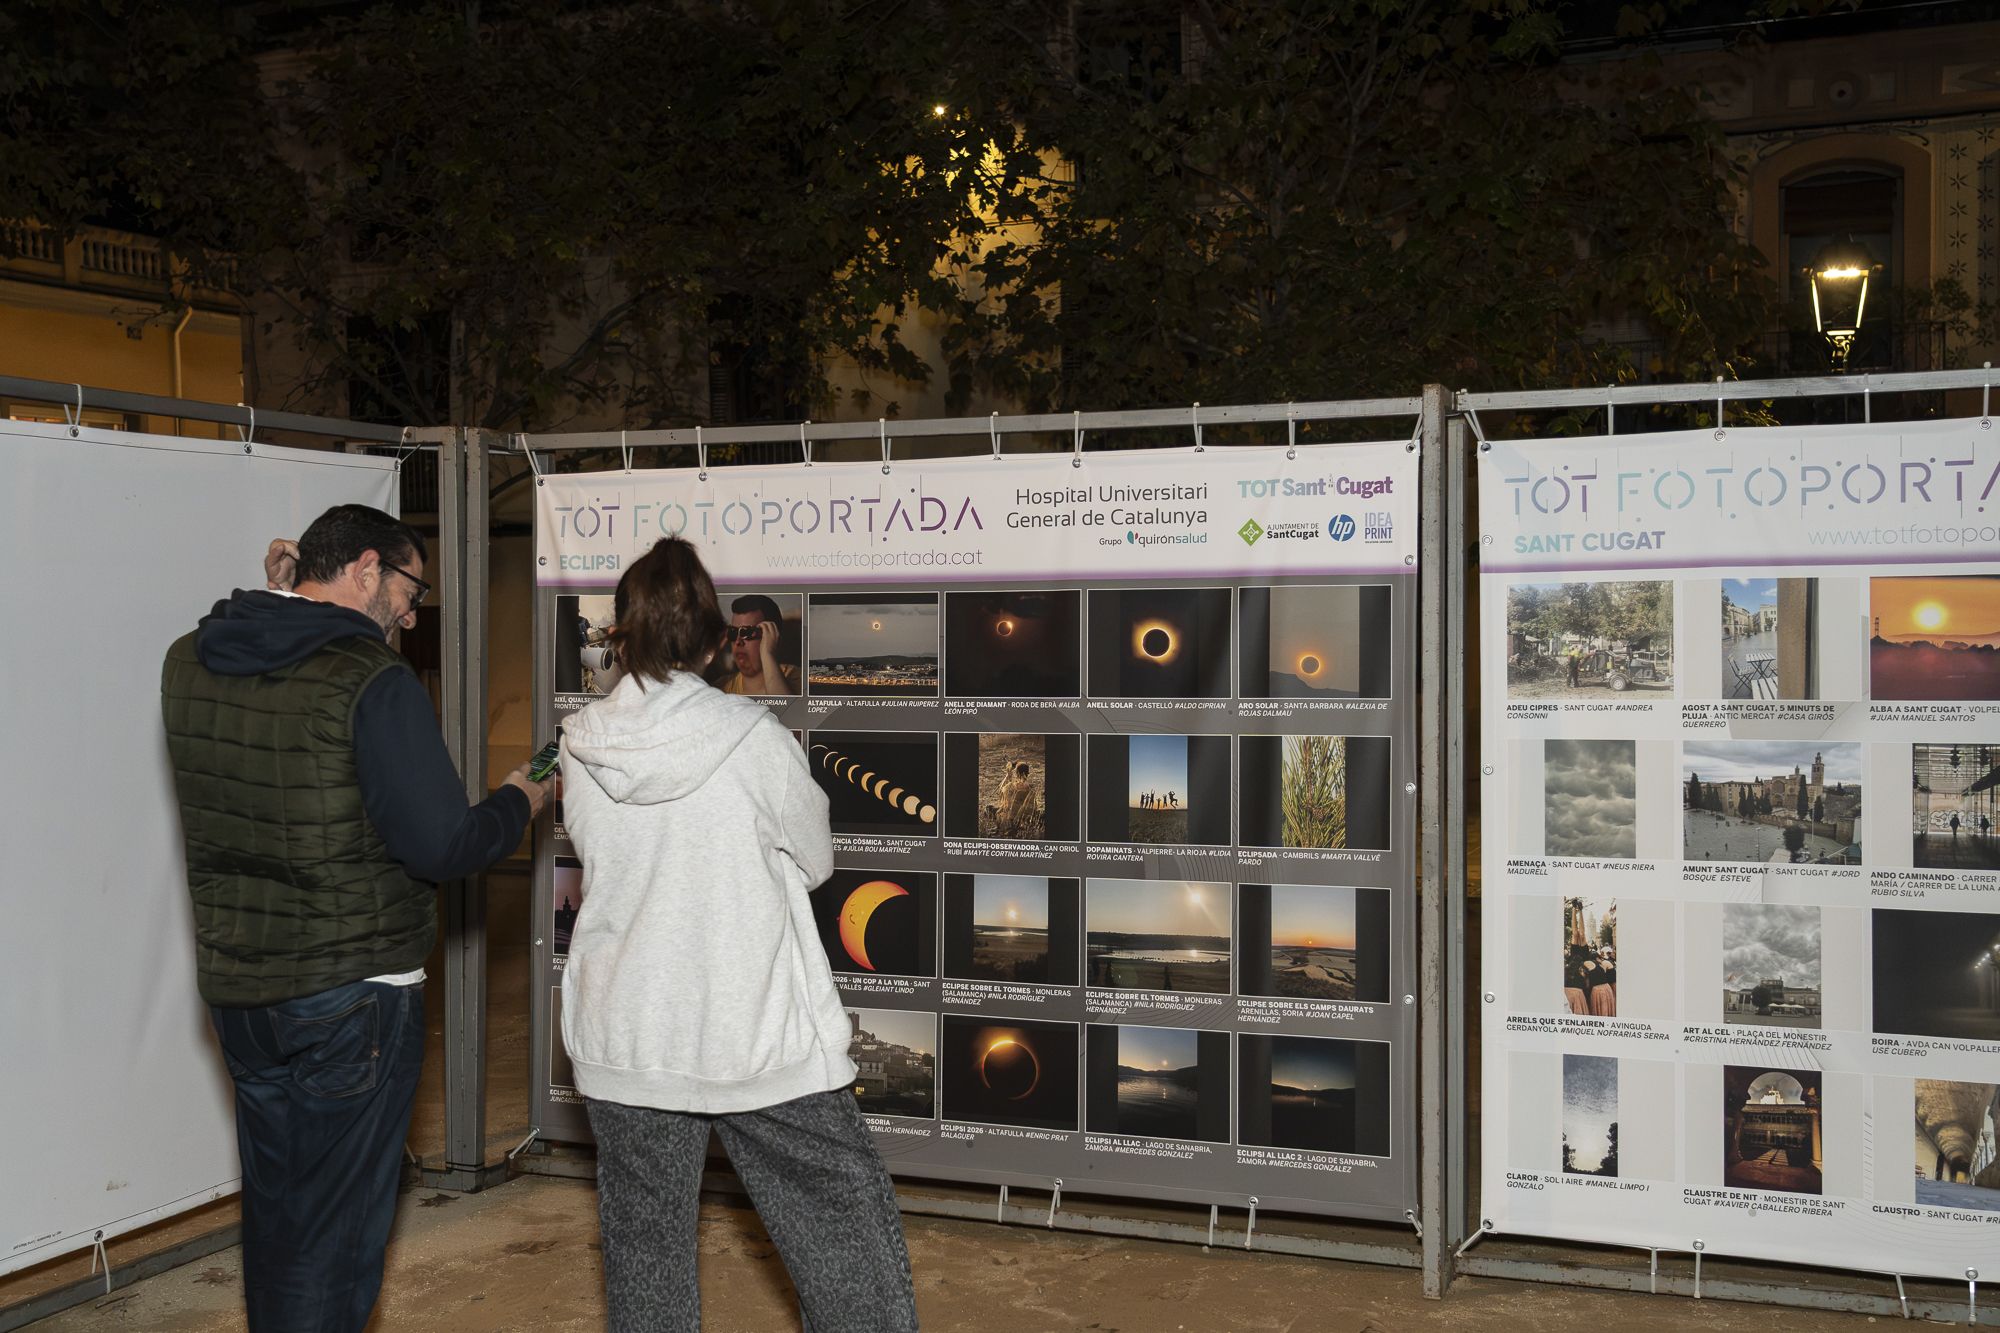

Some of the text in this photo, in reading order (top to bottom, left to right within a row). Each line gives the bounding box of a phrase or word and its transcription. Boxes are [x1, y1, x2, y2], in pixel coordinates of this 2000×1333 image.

[1237, 476, 1393, 498] TOT Sant Cugat
[1504, 466, 1598, 517] TOT
[1016, 482, 1208, 509] Hospital Universitari
[554, 486, 984, 545] TOT FOTOPORTADA
[1006, 508, 1208, 530] General de Catalunya
[1365, 512, 1393, 527] IDEA
[1267, 530, 1319, 540] SantCugat
[1331, 514, 1352, 542] hp
[1365, 528, 1393, 539] PRINT
[1808, 524, 2000, 548] www.totfotopo
[1099, 532, 1208, 548] Grupo quirónsalud
[1514, 531, 1666, 554] SANT CUGAT
[560, 554, 620, 571] ECLIPSI
[766, 549, 984, 570] www.totfotoportada.cat
[963, 848, 990, 856] #MAYTE
[990, 849, 1018, 858] CORTINA
[1237, 851, 1277, 859] ECLIPSADA
[1682, 865, 1712, 874] AMUNT
[1714, 866, 1737, 874] SANT
[1739, 867, 1769, 875] CUGAT
[1775, 868, 1797, 876] SANT
[1799, 869, 1828, 877] CUGAT
[1682, 874, 1751, 882] BOSQUE ESTEVE
[1237, 1000, 1266, 1008] ECLIPSE
[1268, 1001, 1293, 1010] SOBRE
[1309, 1003, 1336, 1012] CAMPS
[1338, 1005, 1373, 1014] DAURATS
[1282, 1009, 1303, 1018] SORIA
[1305, 1011, 1330, 1019] #JOAN
[1331, 1012, 1354, 1020] CAPEL
[1506, 1016, 1537, 1025] ARRELS
[1538, 1017, 1555, 1026] QUE
[1610, 1021, 1651, 1030] AVINGUDA
[1506, 1024, 1558, 1034] CERDANYOLA
[1560, 1027, 1594, 1036] #MIQUEL
[1643, 1032, 1669, 1040] SERRA
[1682, 1027, 1826, 1042] ART AL CEL PLAÇA DEL MONESTIR
[1683, 1035, 1727, 1045] #CRISTINA
[1781, 1039, 1832, 1050] FERNÁNDEZ
[1236, 1149, 1264, 1158] ECLIPSI
[1277, 1153, 1295, 1161] LLAC
[1307, 1155, 1326, 1164] LAGO
[1236, 1156, 1266, 1166] ZAMORA
[1268, 1159, 1312, 1170] #MERCEDES
[1506, 1173, 1538, 1183] CLAROR
[1544, 1176, 1559, 1184] SOL
[1565, 1177, 1582, 1186] AIRE
[1585, 1179, 1617, 1189] #MANEL
[1619, 1182, 1645, 1191] LIMPO
[1506, 1181, 1544, 1191] GONZALO
[1683, 1188, 1845, 1209] CLAUSTRE DE NIT MONESTIR DE SANT
[1683, 1197, 1832, 1216] CUGAT #XAVIER CABALLERO RIBERA
[1872, 1205, 1920, 1217] CLAUSTRO
[1927, 1210, 1950, 1220] SANT
[1952, 1212, 1983, 1223] CUGAT
